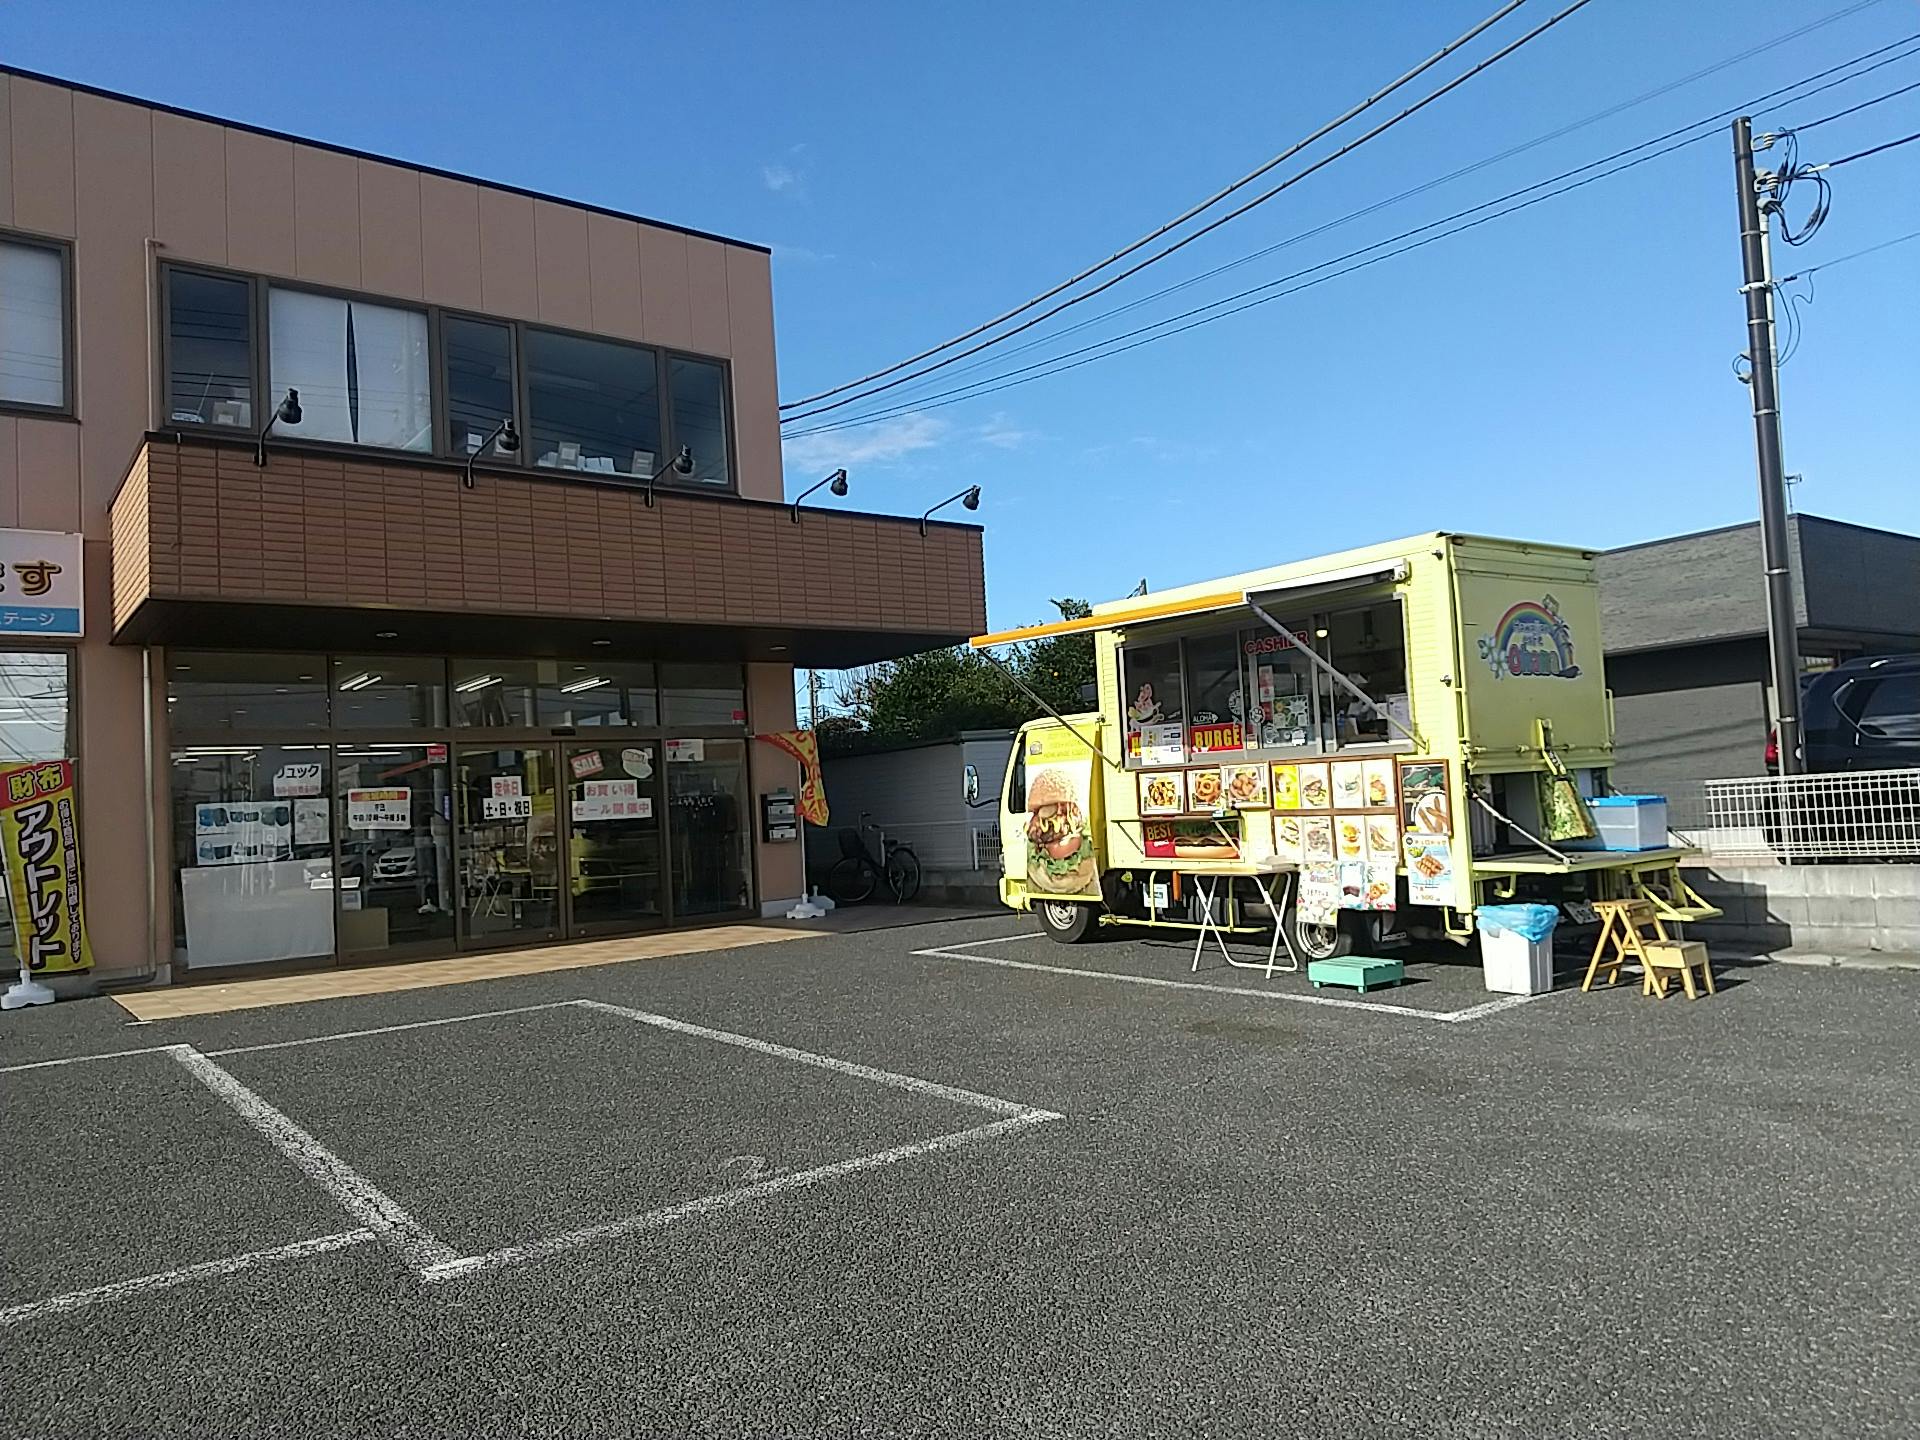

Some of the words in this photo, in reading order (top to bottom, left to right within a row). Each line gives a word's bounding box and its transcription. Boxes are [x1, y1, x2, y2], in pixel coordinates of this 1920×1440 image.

[0, 560, 62, 596] す
[0, 612, 55, 627] テージ
[8, 763, 64, 802] 財布
[586, 783, 635, 797] お買い得
[574, 803, 649, 816] セール開催中
[1146, 823, 1172, 841] BEST
[14, 800, 66, 969] アウトレット
